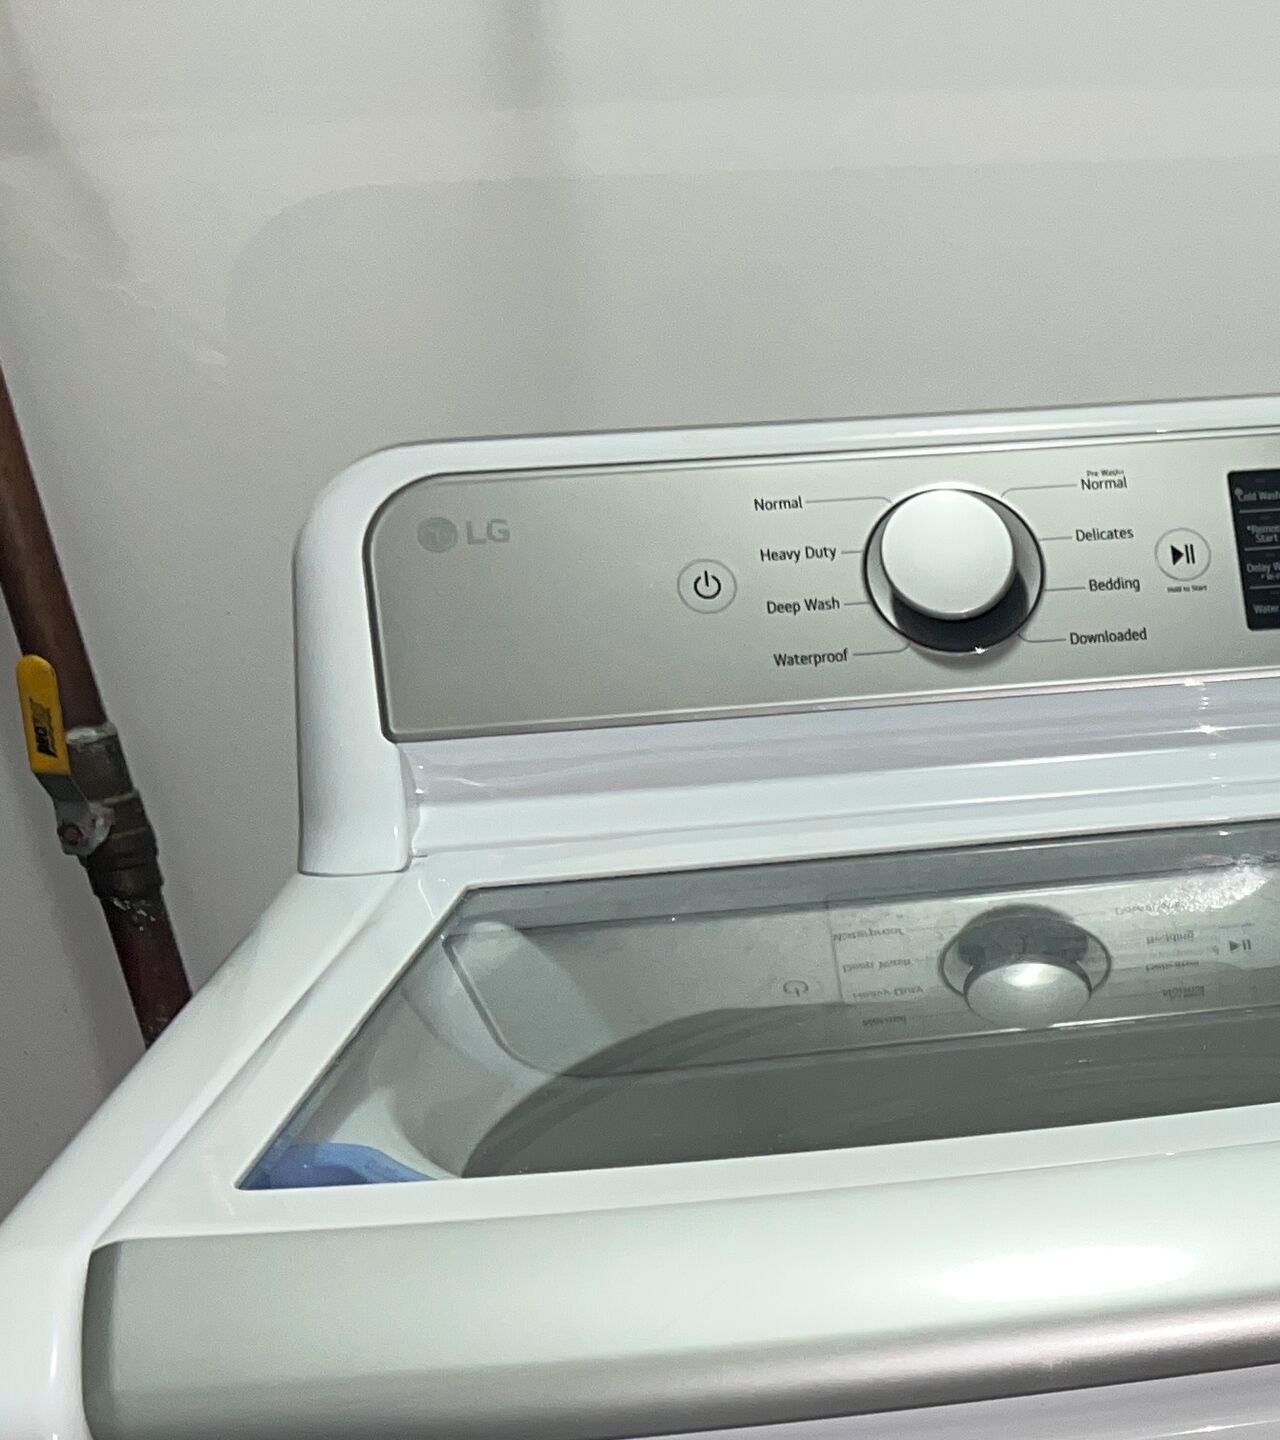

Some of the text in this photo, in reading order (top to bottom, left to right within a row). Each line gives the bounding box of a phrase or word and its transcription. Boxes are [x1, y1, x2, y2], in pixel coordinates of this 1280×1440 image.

[1081, 477, 1128, 490] Normal
[754, 496, 802, 511] Normal
[1076, 528, 1134, 541] Delicates
[1256, 534, 1278, 544] Start
[760, 546, 837, 563] Heavy Duty
[1089, 577, 1140, 592] Bedding
[767, 597, 840, 616] Deep Wash
[1253, 603, 1280, 614] Water
[1069, 627, 1147, 645] Downloaded
[773, 648, 848, 667] Waterproof
